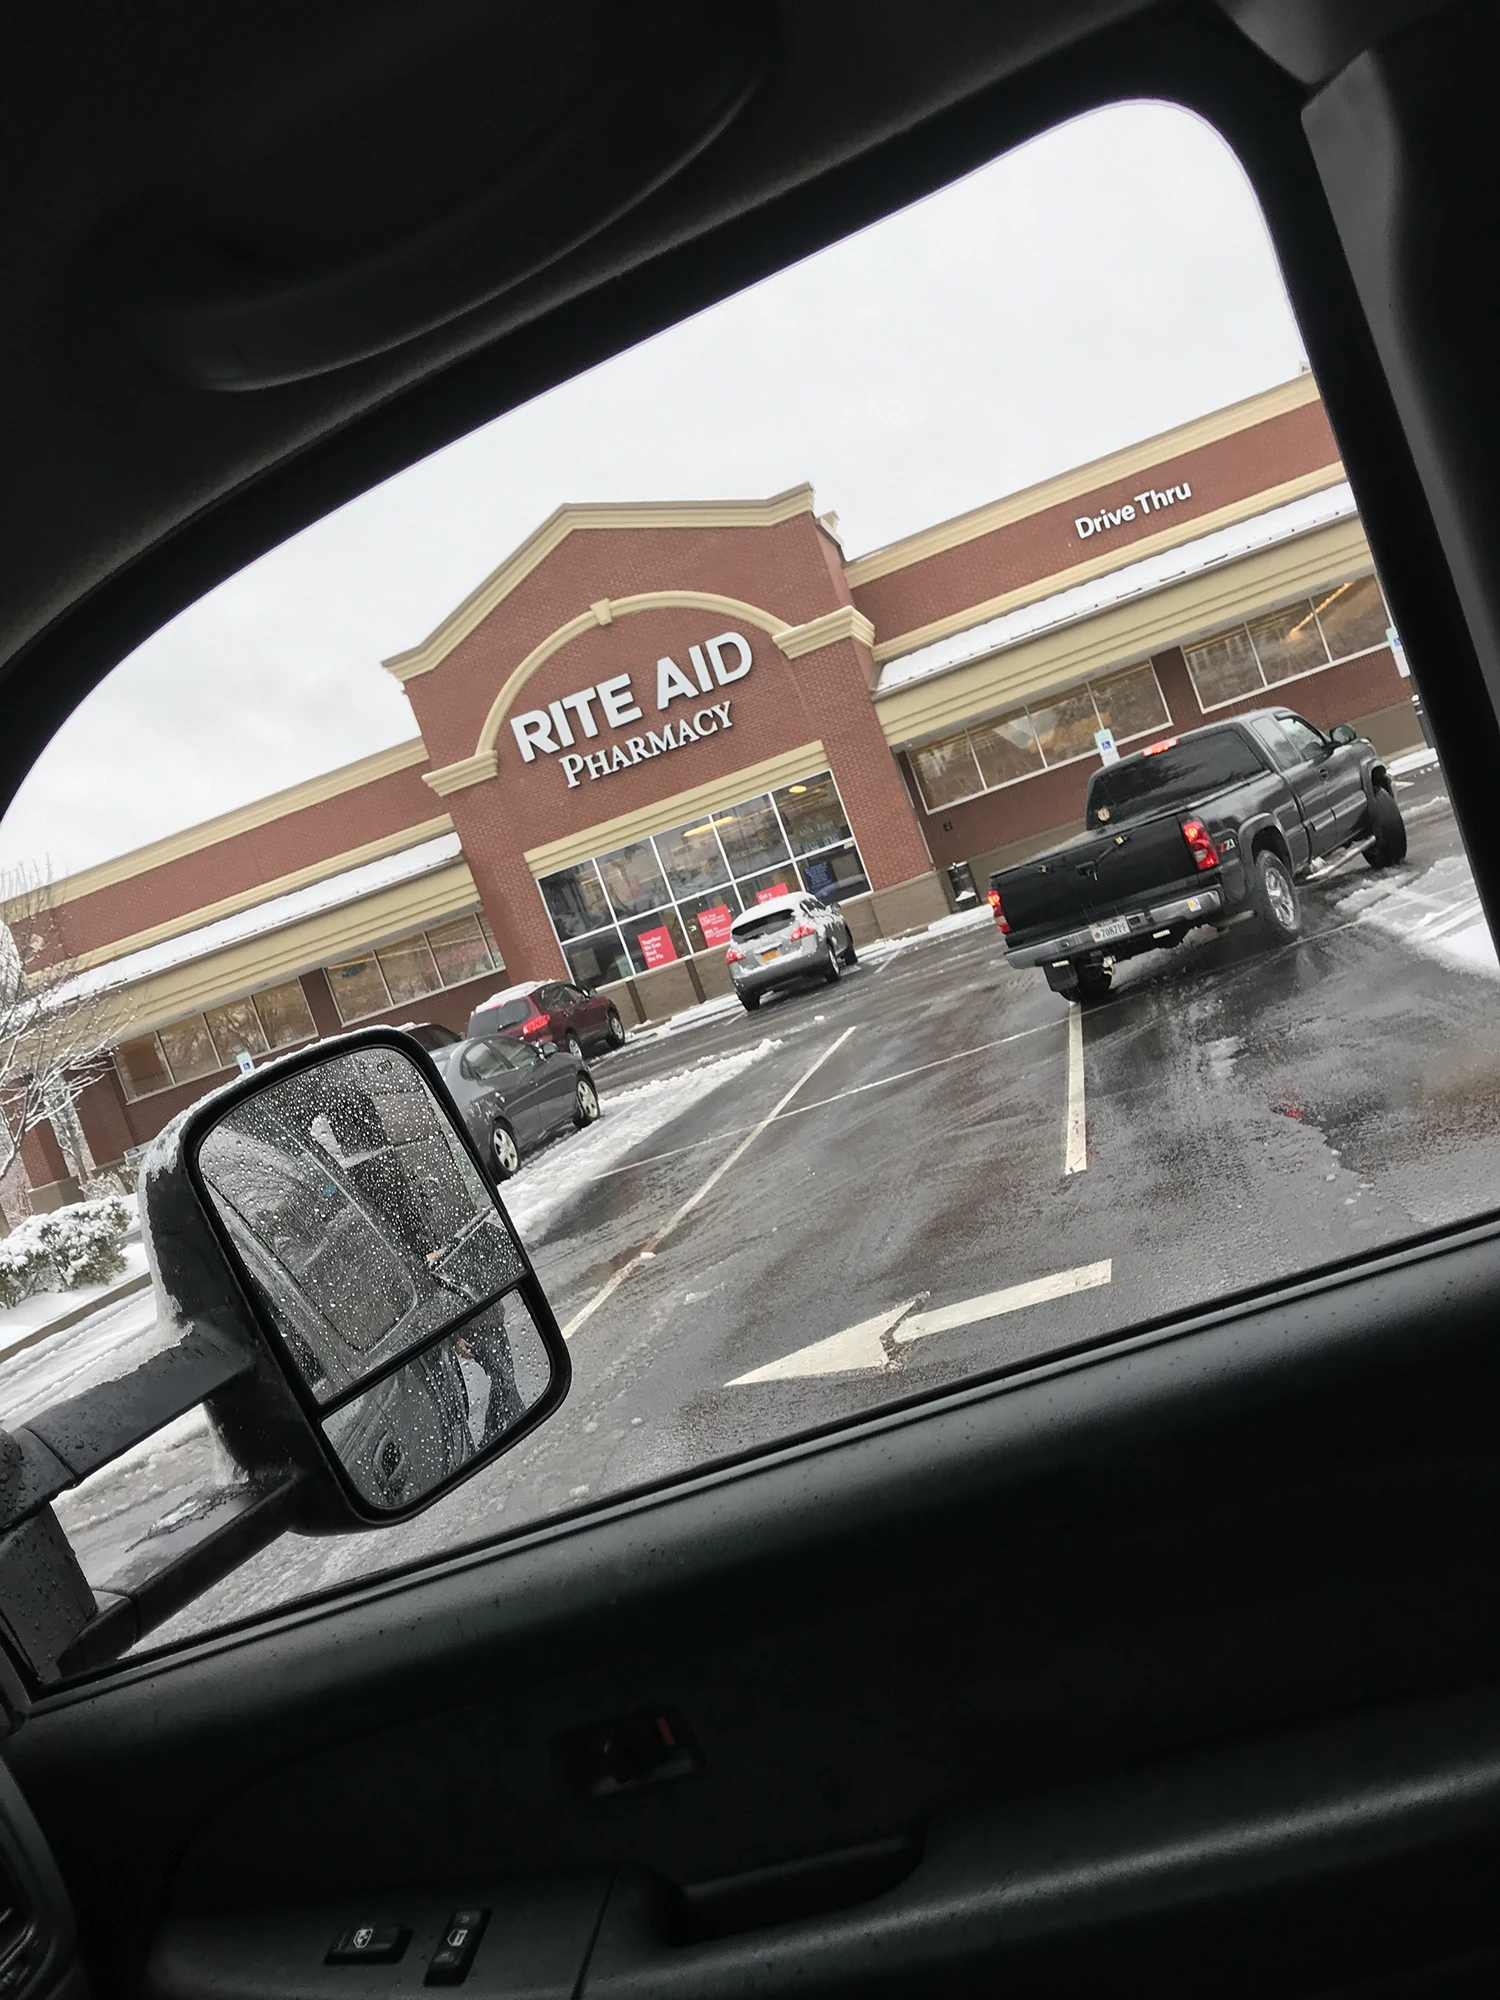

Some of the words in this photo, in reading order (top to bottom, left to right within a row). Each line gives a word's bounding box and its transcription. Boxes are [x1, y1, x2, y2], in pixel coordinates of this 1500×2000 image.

[1074, 504, 1136, 540] Drive
[1134, 482, 1192, 515] Thru
[509, 672, 644, 764] RITE
[656, 631, 753, 711] AID
[558, 700, 734, 789] PHARMACY
[1218, 838, 1237, 853] Z71
